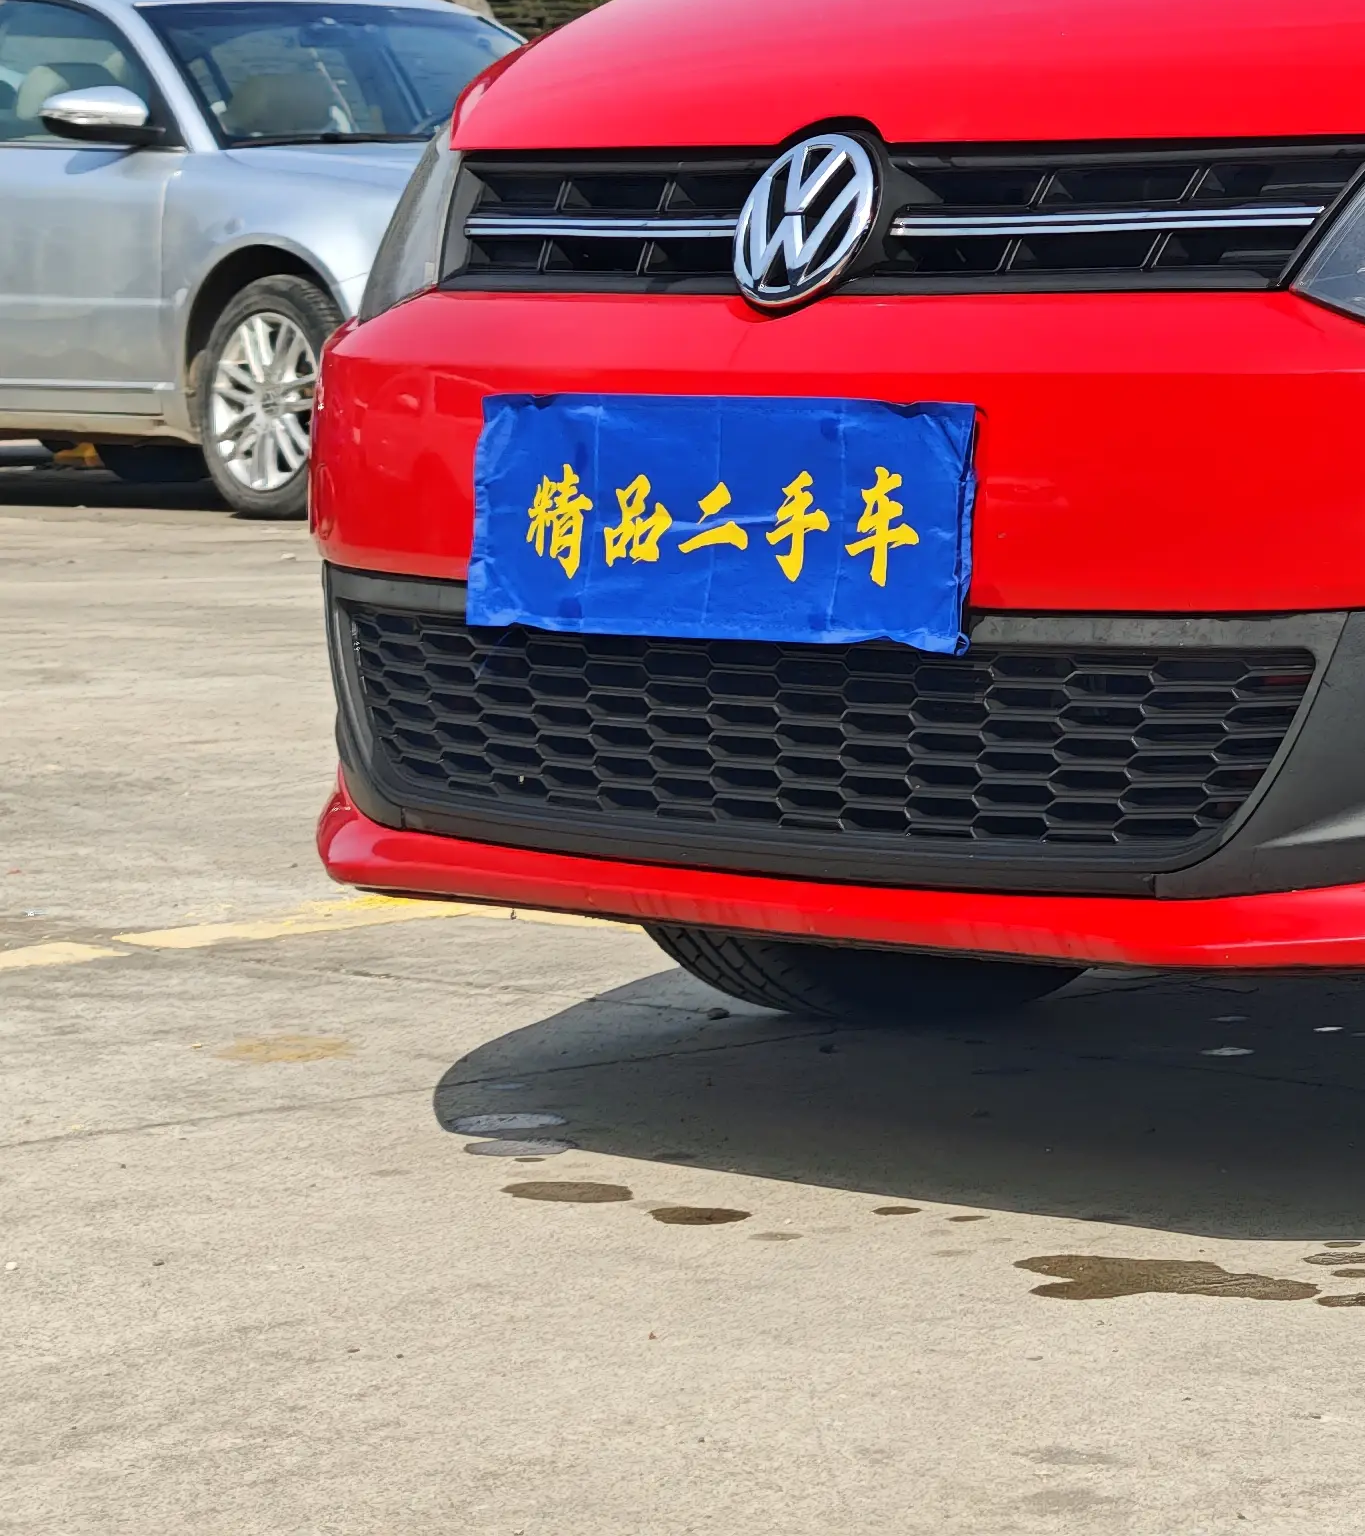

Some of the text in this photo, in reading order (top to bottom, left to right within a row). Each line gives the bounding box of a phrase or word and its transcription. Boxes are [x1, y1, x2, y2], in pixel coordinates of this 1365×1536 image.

[526, 464, 919, 586] 精品二手车
